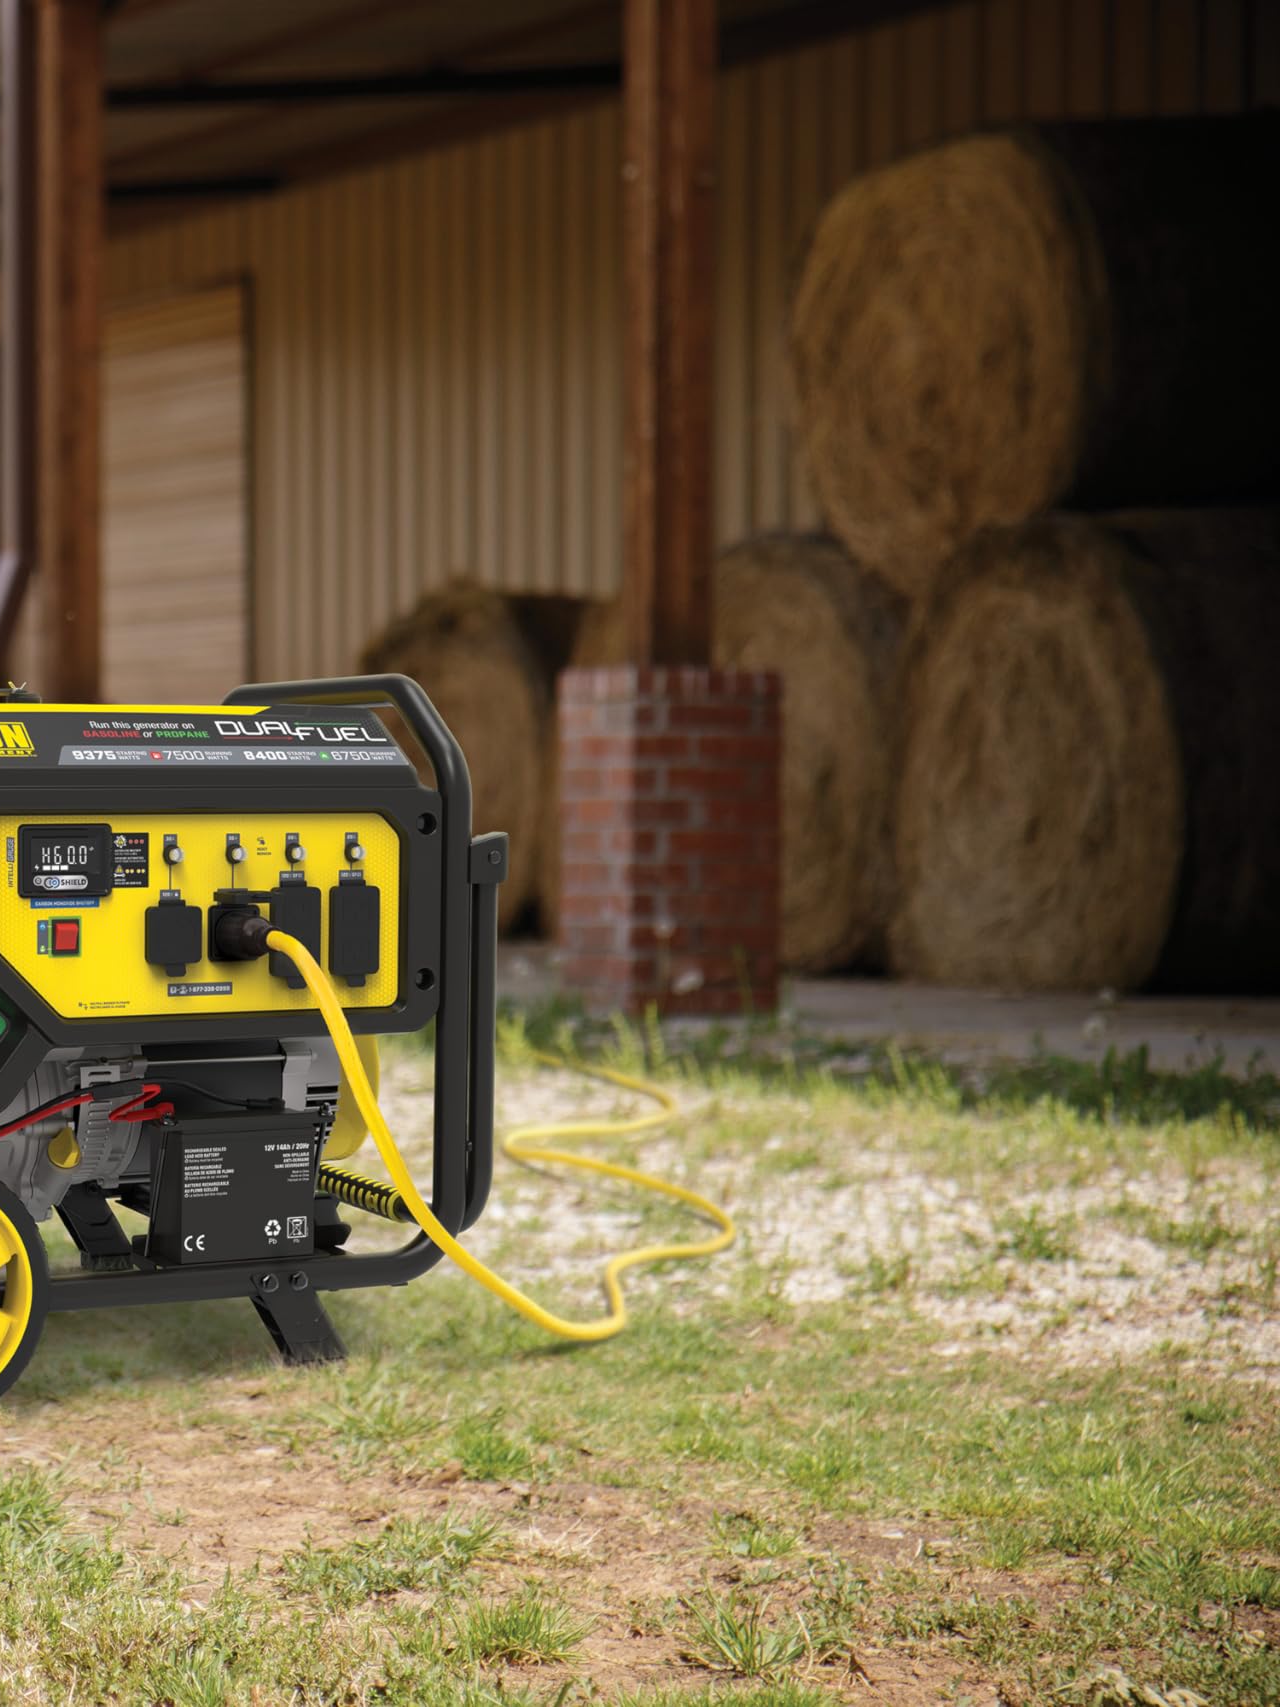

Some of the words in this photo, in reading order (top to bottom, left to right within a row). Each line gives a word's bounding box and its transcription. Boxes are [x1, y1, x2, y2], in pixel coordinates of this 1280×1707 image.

[88, 720, 109, 729] Run
[111, 720, 131, 729] this
[133, 721, 179, 730] generator
[82, 730, 142, 738] GASOLINE
[72, 750, 117, 760] 9375
[162, 751, 205, 761] 7500
[243, 751, 288, 760] 8400
[331, 751, 371, 761] 6750
[60, 878, 87, 886] SHIELD
[184, 1234, 205, 1252] CE
